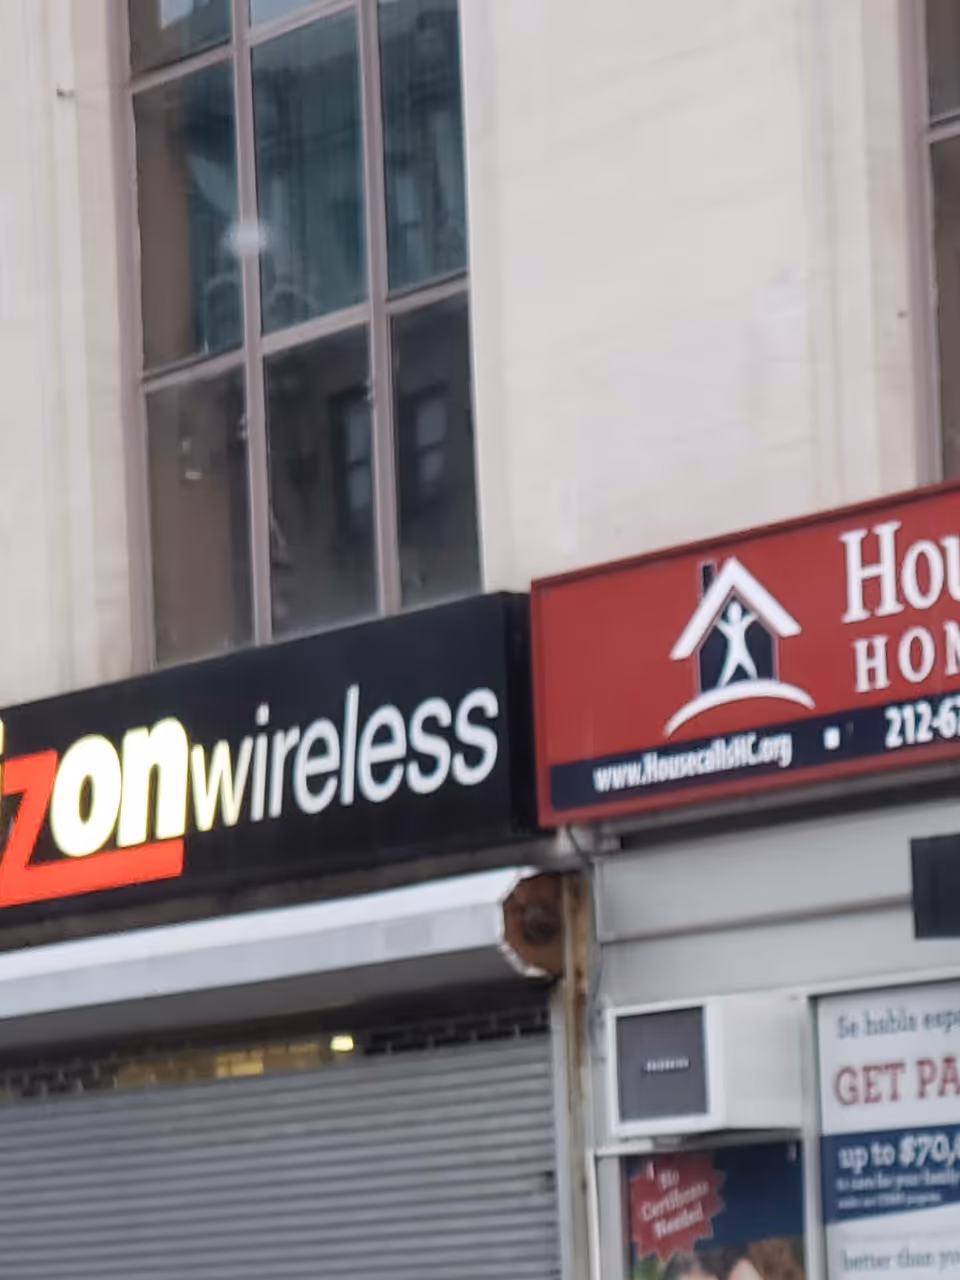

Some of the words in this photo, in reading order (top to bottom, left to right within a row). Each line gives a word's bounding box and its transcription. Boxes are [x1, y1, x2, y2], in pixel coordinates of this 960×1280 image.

[0, 716, 190, 906] zon
[190, 684, 500, 832] wireless
[864, 1006, 918, 1036] habla
[834, 1061, 905, 1106] GET
[838, 1144, 868, 1175] up
[873, 1140, 895, 1166] to
